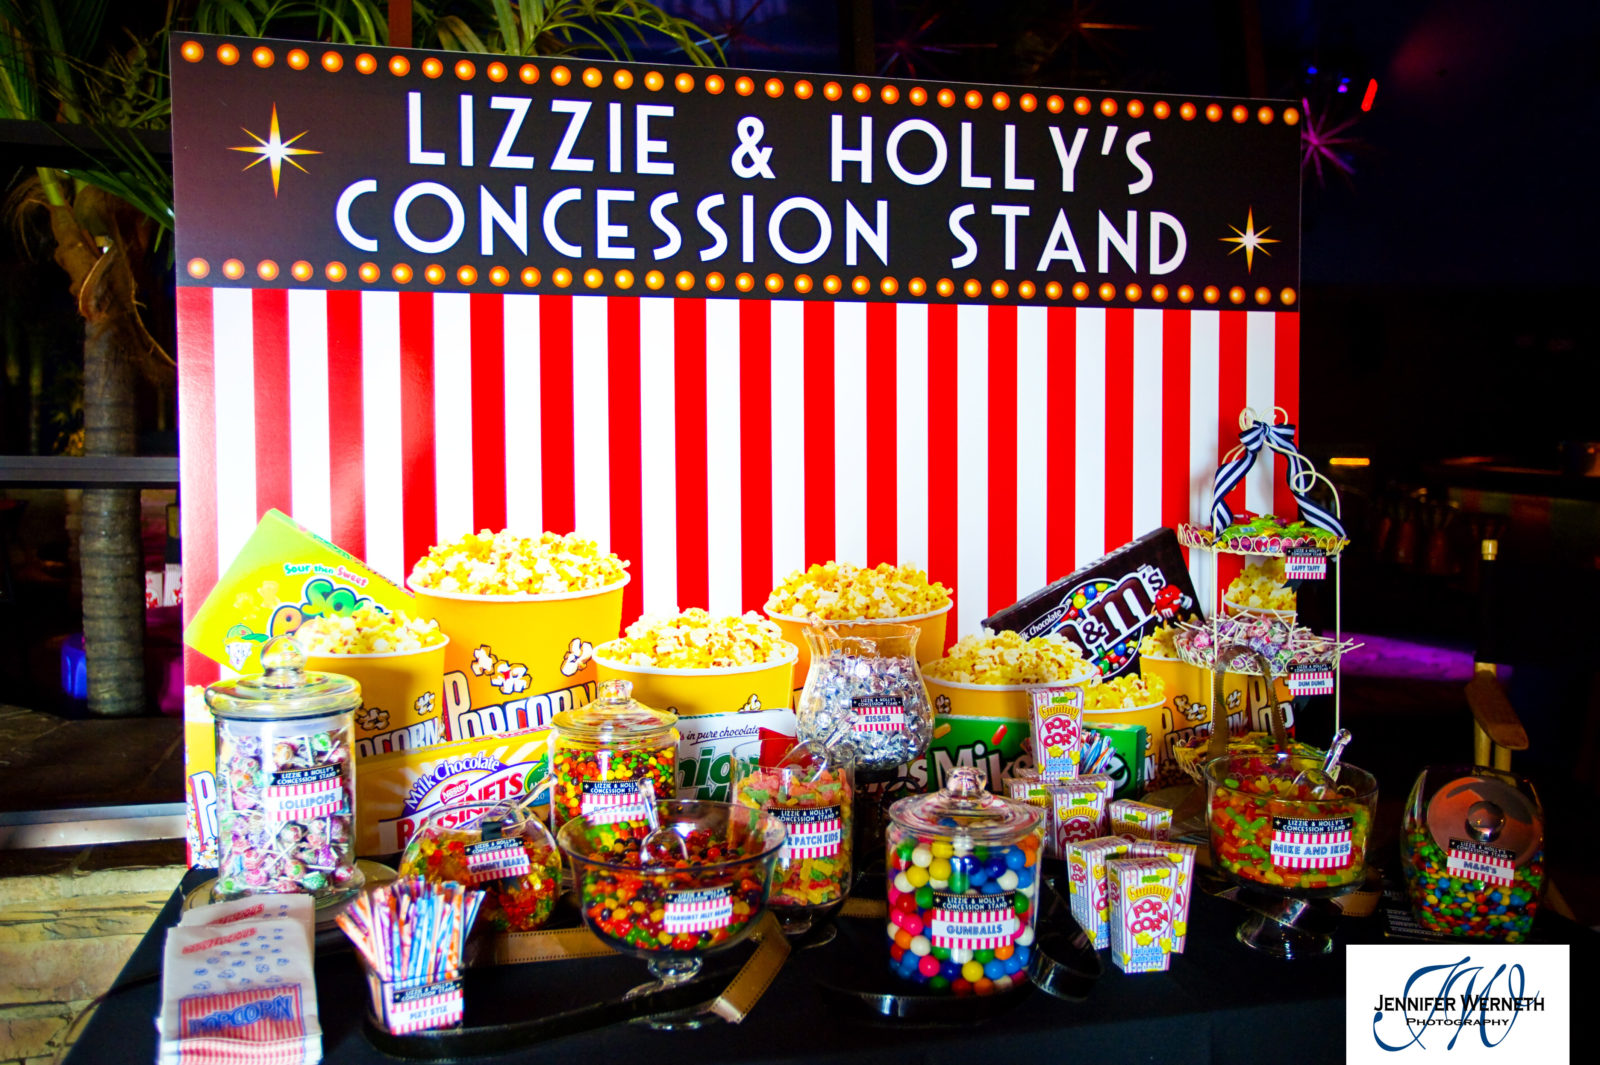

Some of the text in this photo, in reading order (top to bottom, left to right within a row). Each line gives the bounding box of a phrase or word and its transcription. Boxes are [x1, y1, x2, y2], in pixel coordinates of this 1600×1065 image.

[408, 92, 1153, 195] LIZZIE & HOLLY'S
[336, 179, 1187, 275] CONCESSION STAND
[284, 563, 310, 575] Sour
[337, 566, 368, 587] Sweet
[1029, 610, 1062, 636] Chocolate
[1038, 704, 1080, 720] Gummy
[687, 731, 696, 740] in
[697, 728, 718, 743] pure
[719, 724, 759, 738] chocolate
[1045, 717, 1071, 734] POP
[1043, 727, 1077, 747] CORN
[406, 774, 438, 809] Milk
[434, 752, 500, 781] Chocolate
[280, 792, 335, 810] LOLLIPOPS
[810, 808, 833, 816] HOLLY'S
[1058, 806, 1099, 822] Gummy
[1063, 819, 1090, 836] POP
[794, 836, 822, 846] PATCH
[824, 832, 839, 843] KIDS
[1274, 843, 1350, 855] MIKE AND IKES
[471, 857, 525, 873] GUMMY BEARS
[948, 896, 968, 904] LIZZIE
[979, 896, 1005, 904] HOLLY'S
[1126, 884, 1173, 903] Gummy
[942, 901, 1008, 910] CONCESSION STAND
[1133, 899, 1162, 918] POP
[946, 924, 1003, 935] GUMBALLS
[1130, 910, 1168, 934] CORN
[188, 995, 294, 1036] POPCORN
